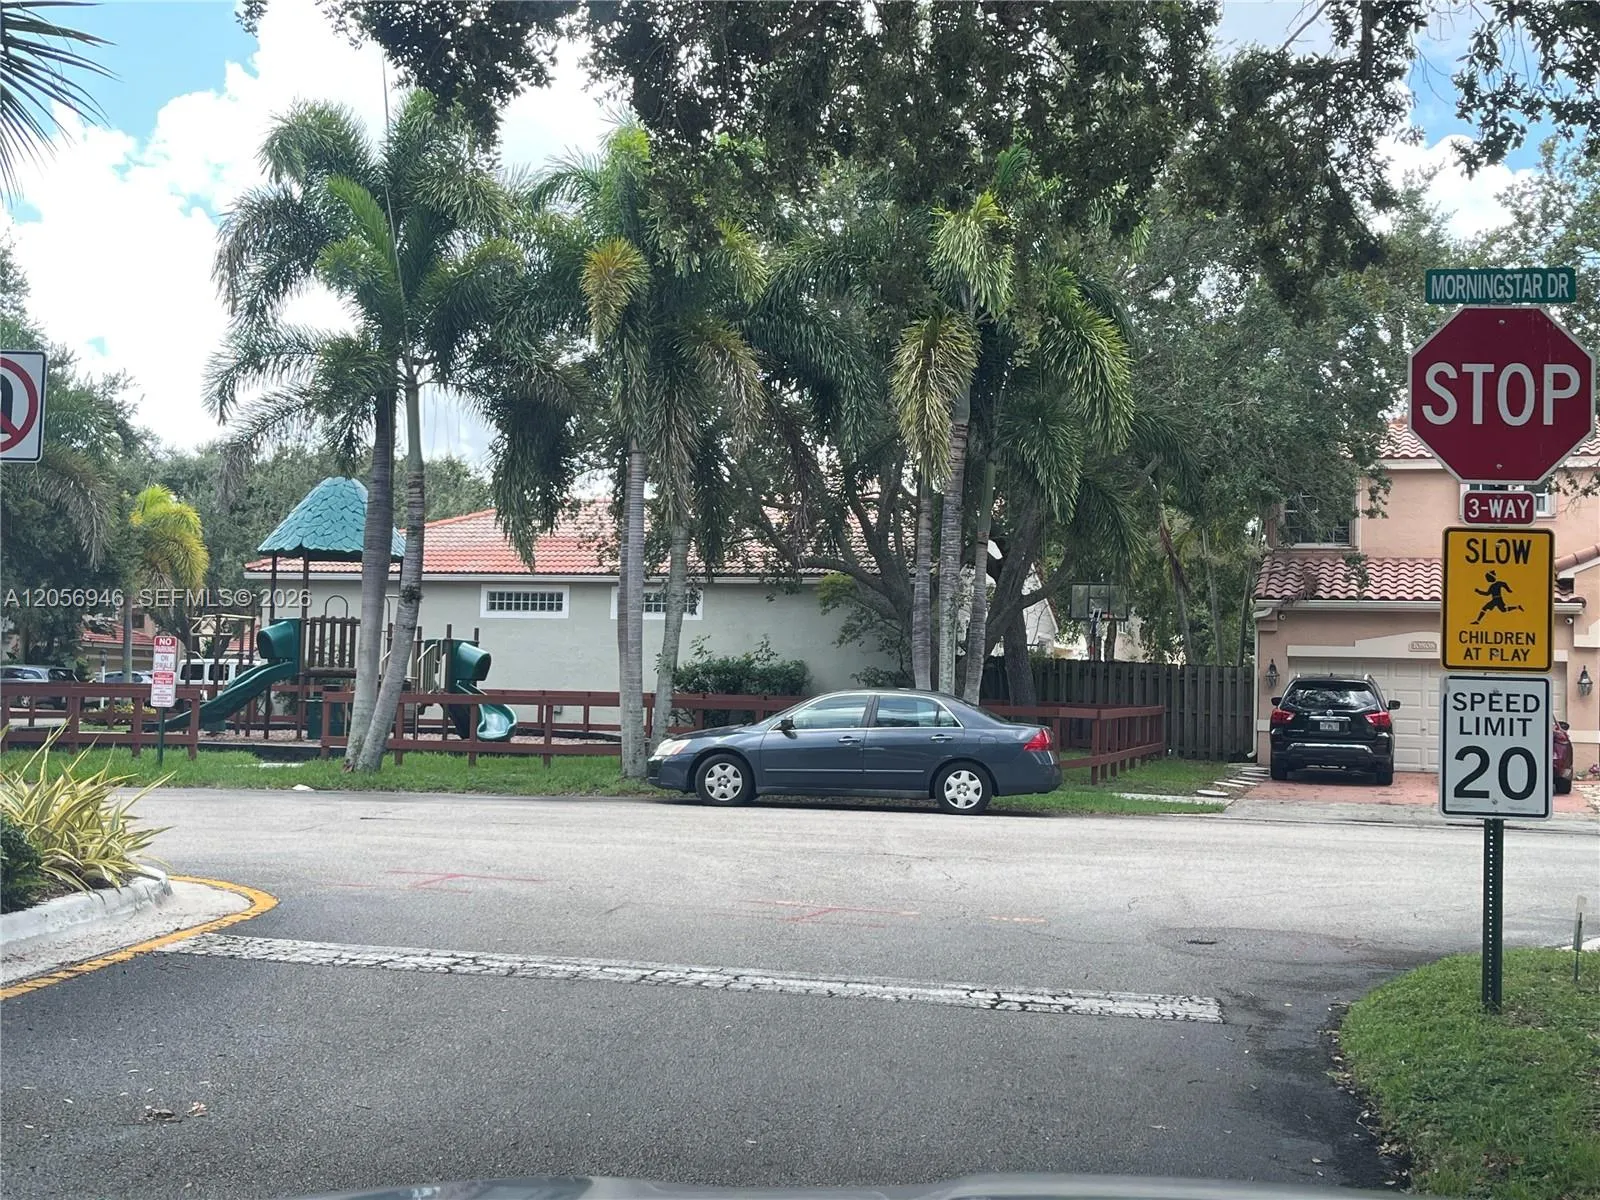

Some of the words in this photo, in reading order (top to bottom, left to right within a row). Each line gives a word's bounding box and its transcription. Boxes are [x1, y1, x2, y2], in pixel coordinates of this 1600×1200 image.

[1431, 273, 1543, 299] MORNINGSTAR
[1547, 273, 1569, 298] DR
[1421, 362, 1581, 426] STOP
[1468, 498, 1530, 519] 3-WAY
[1465, 538, 1532, 564] SLOW
[159, 638, 172, 646] NO
[1458, 630, 1536, 645] CHILDREN
[1463, 647, 1482, 661] AT
[1489, 648, 1531, 662] PLAY
[1452, 692, 1541, 713] SPEED
[1459, 716, 1533, 737] LIMIT
[1454, 745, 1538, 801] 20
